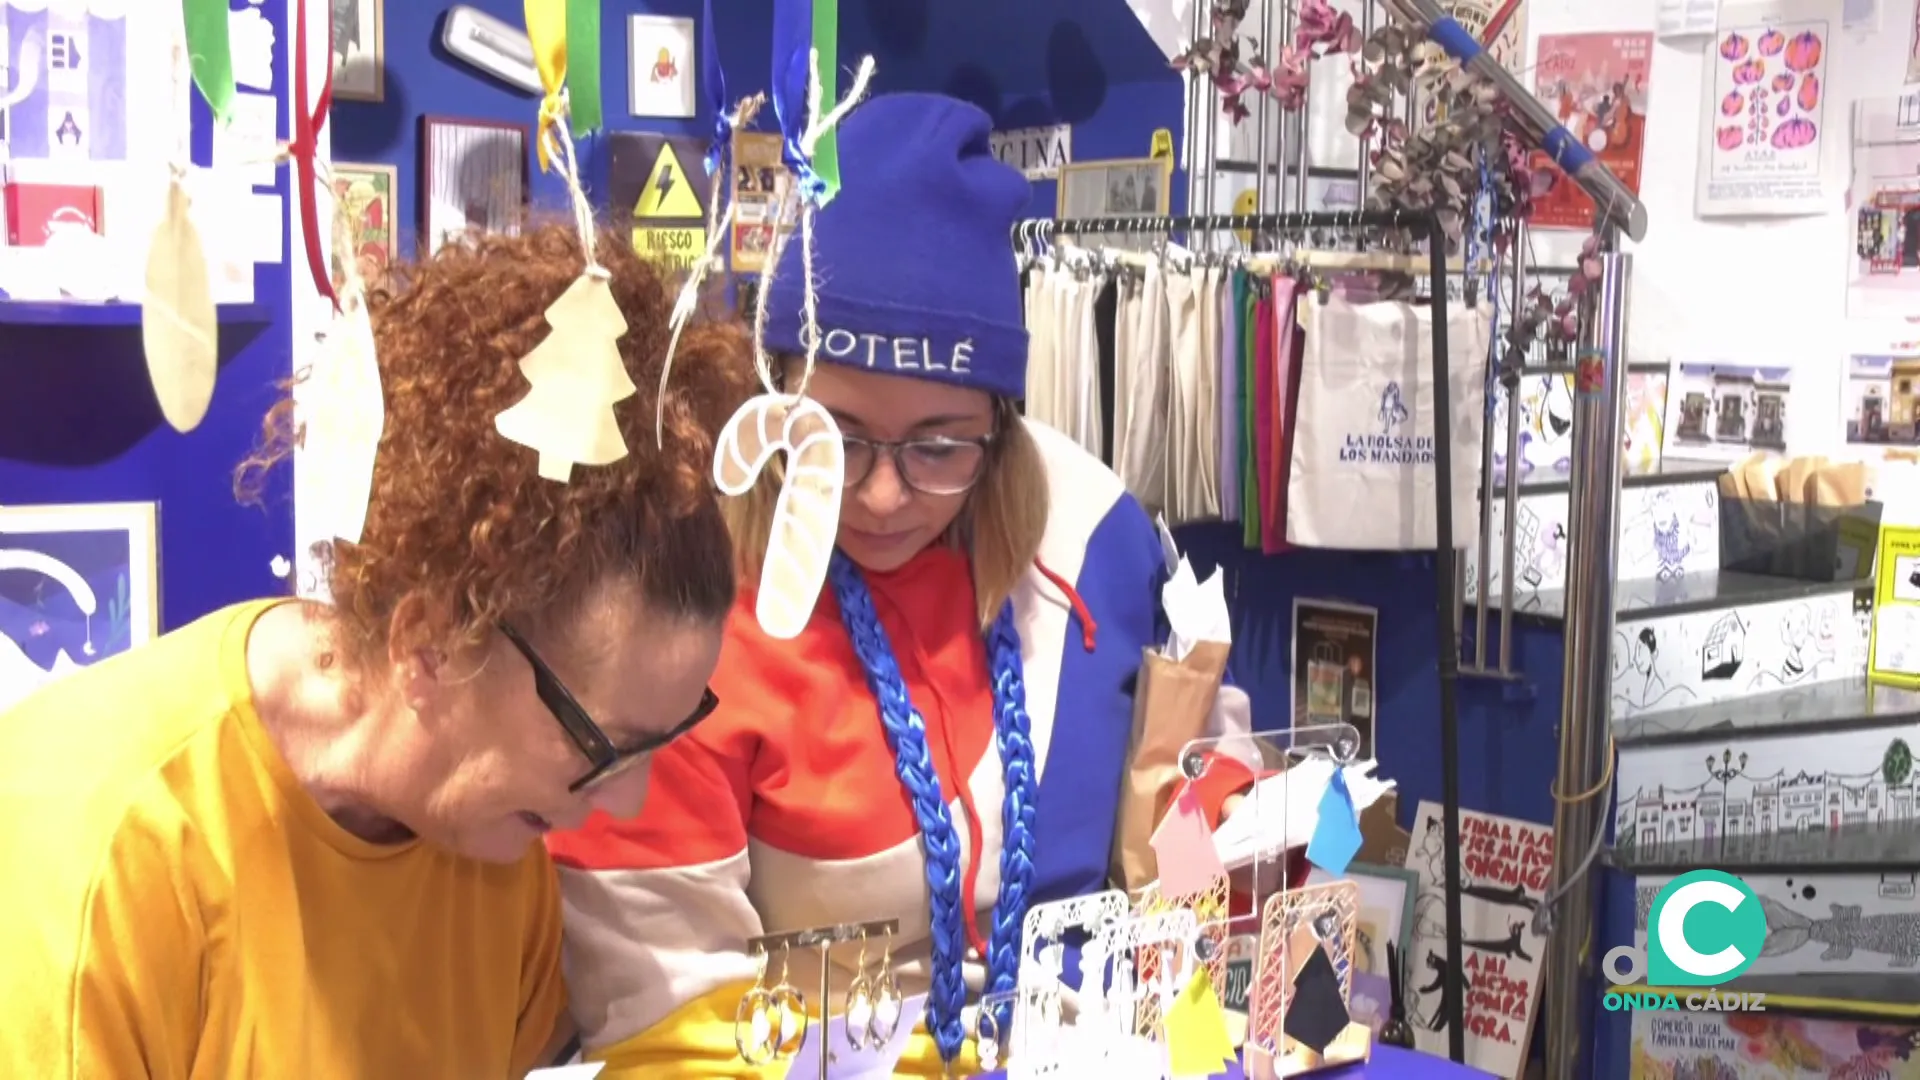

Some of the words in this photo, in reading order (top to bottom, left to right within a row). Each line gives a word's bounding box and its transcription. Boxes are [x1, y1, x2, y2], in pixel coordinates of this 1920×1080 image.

[1346, 433, 1365, 448] LA
[1367, 434, 1412, 449] BOLSA
[1339, 447, 1367, 462] LOS
[1464, 951, 1480, 970] A
[1484, 955, 1506, 975] MI
[1471, 970, 1529, 999] MEJOR
[1698, 1022, 1721, 1037] LOCAL
